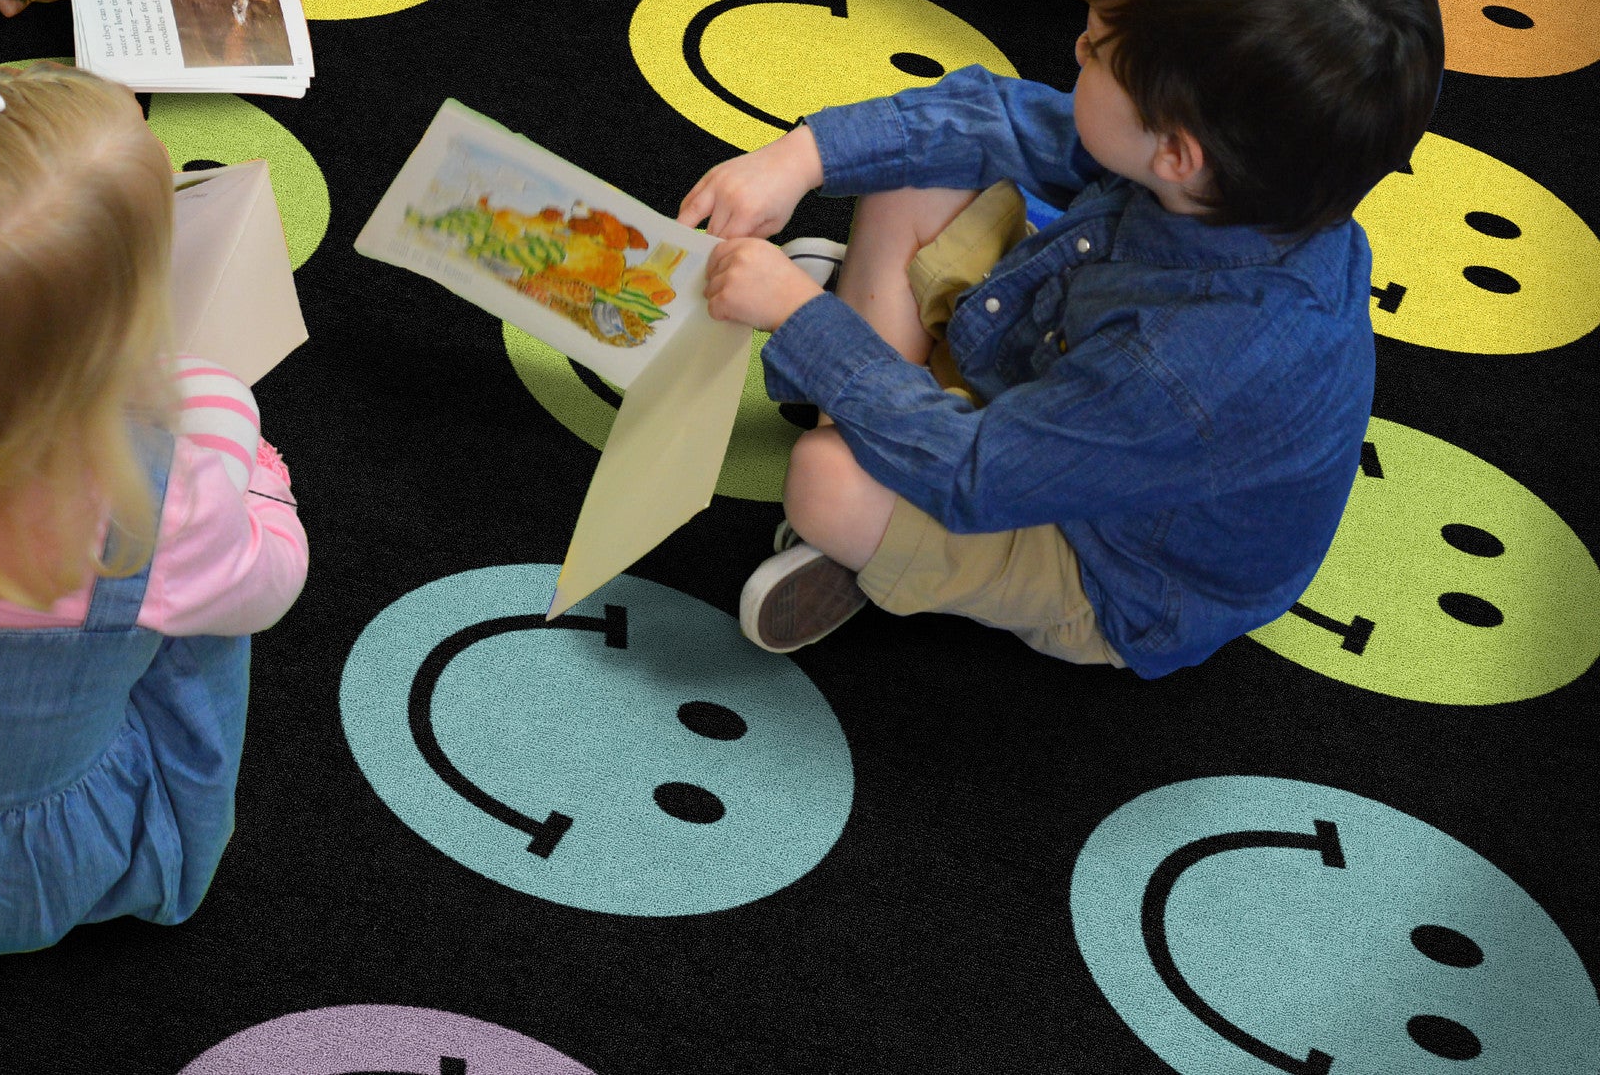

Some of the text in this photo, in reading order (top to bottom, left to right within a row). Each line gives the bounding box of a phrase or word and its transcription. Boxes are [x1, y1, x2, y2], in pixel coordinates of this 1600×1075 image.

[140, 1, 148, 12] for
[153, 0, 162, 13] and
[114, 8, 122, 25] long
[144, 14, 153, 33] hour
[103, 25, 111, 40] they
[131, 19, 143, 56] breathing
[158, 17, 172, 55] crocodiles
[106, 43, 114, 57] But
[120, 35, 128, 56] water
